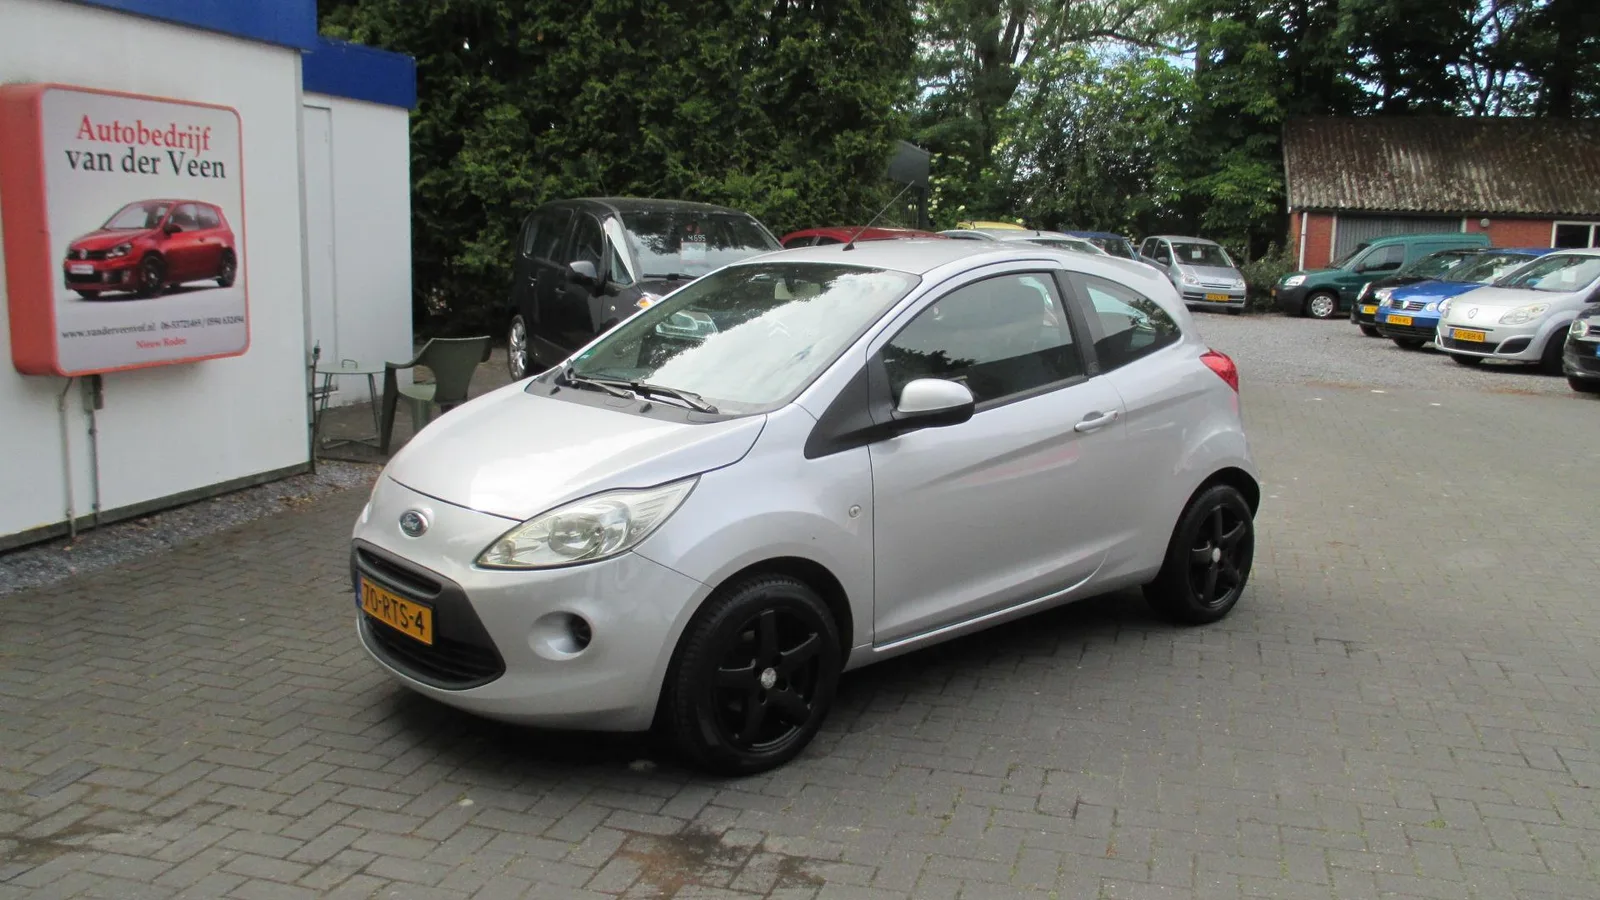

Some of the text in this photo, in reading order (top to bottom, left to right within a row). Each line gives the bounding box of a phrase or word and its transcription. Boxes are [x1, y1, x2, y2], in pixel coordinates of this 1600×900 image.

[76, 114, 212, 157] Autobedrijf
[65, 147, 226, 178] van der Veen
[362, 582, 426, 637] 70-RTS-4
